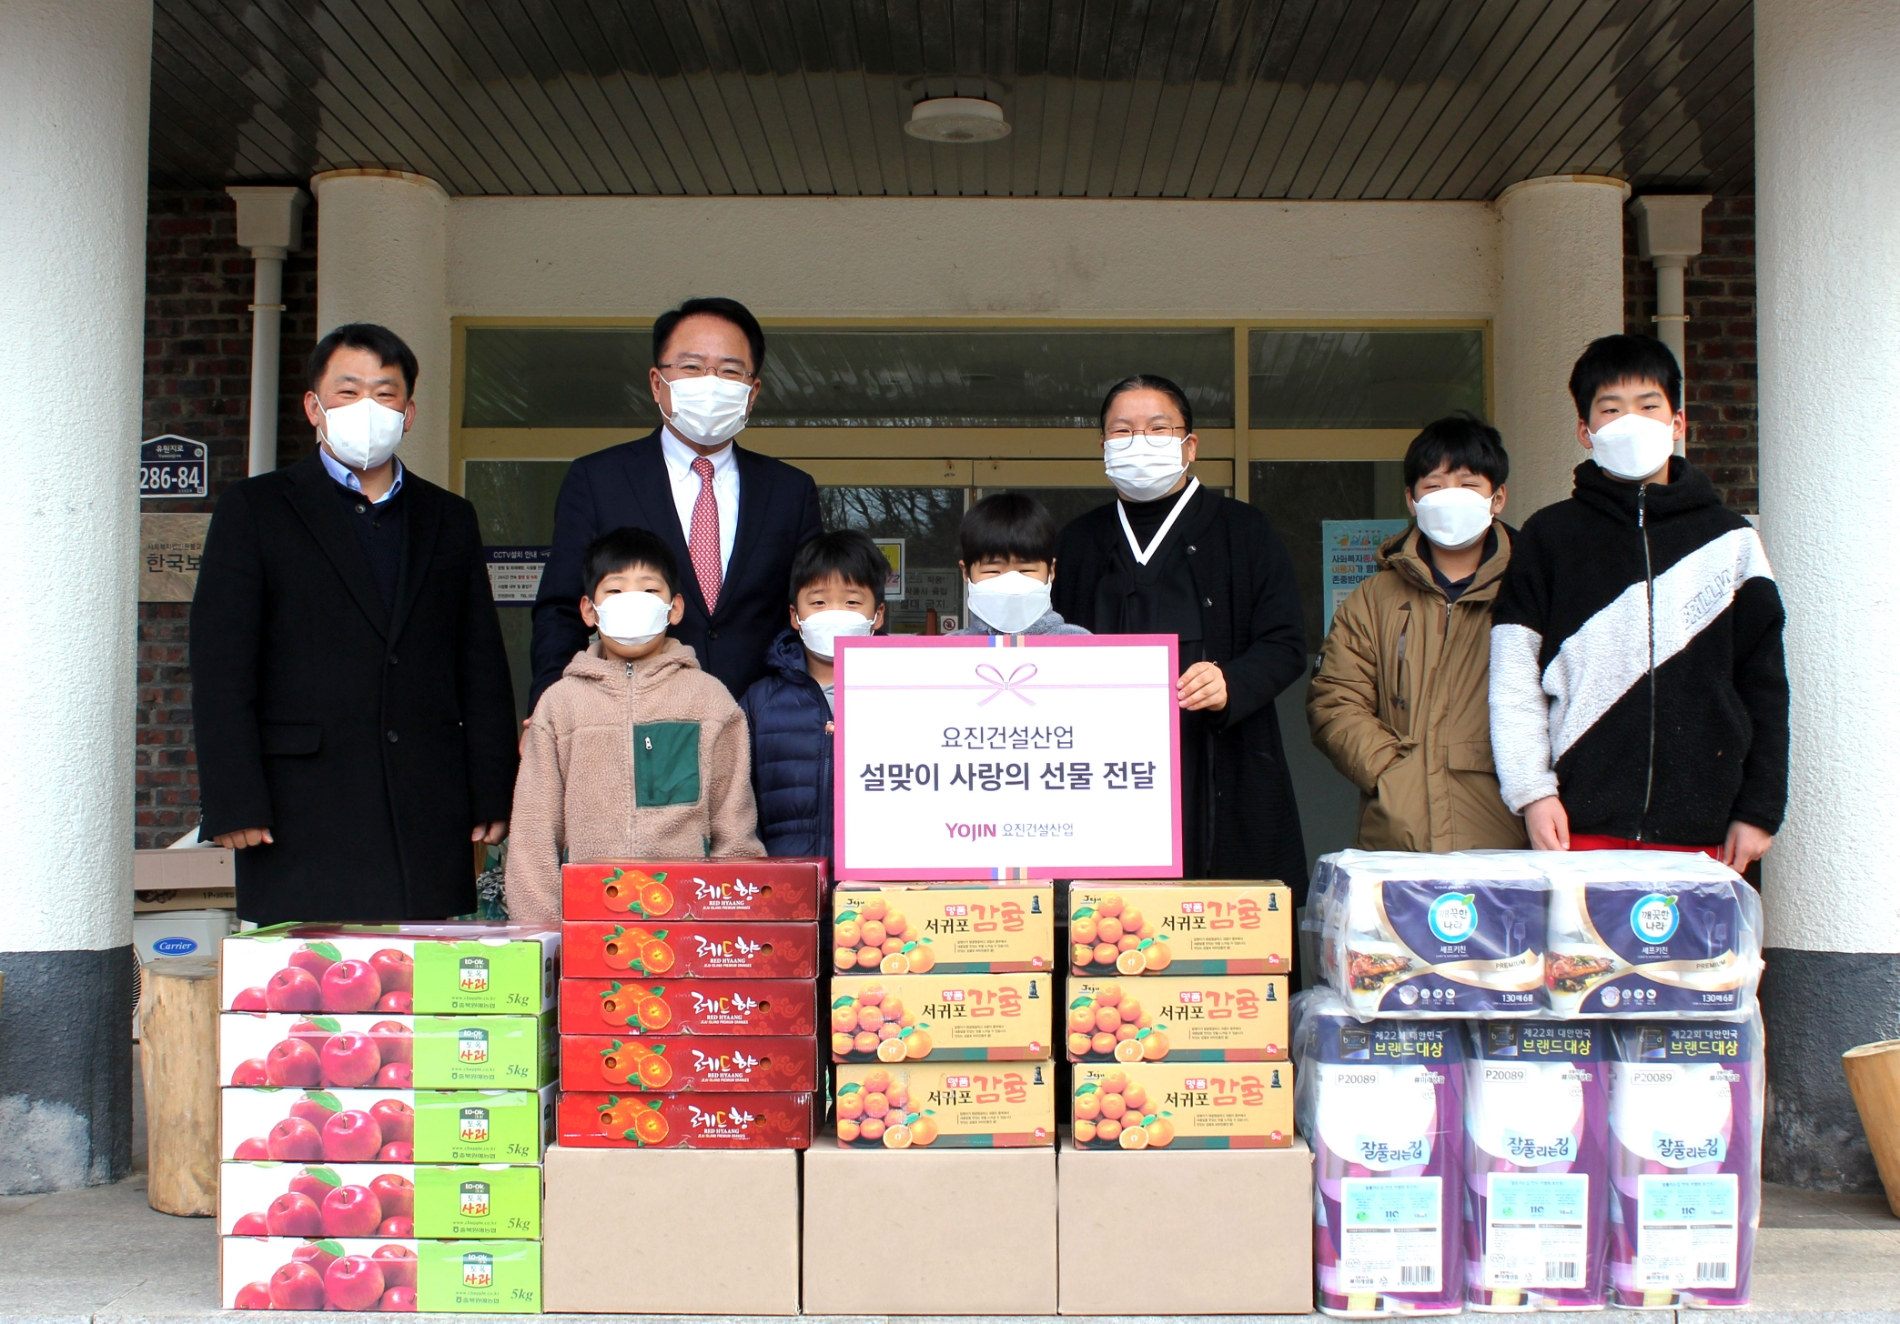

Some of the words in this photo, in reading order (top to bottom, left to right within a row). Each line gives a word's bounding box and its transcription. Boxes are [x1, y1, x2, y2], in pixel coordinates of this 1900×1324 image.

[155, 444, 185, 454] 유원지로
[140, 466, 200, 490] 286-84
[493, 550, 523, 559] CCTV설치
[524, 550, 538, 559] 안내
[1332, 565, 1363, 574] 이용자가
[940, 725, 1075, 750] 요진건설산업
[859, 762, 940, 792] 설맞이
[949, 762, 1030, 791] 사랑의
[1039, 761, 1094, 791] 선물
[1102, 760, 1157, 790] 전달
[944, 822, 997, 842] YOJIN
[1002, 822, 1075, 838] 요진건설산업
[692, 877, 760, 901] 레드향
[846, 898, 866, 908] Jeju
[1084, 896, 1102, 905] Jeju
[946, 906, 967, 916] 명품
[1183, 903, 1204, 913] 명품
[1438, 908, 1468, 920] 깨끗한
[924, 918, 970, 934] 서귀포
[970, 901, 1026, 932] 감귤
[1162, 915, 1208, 932] 서귀포
[1208, 898, 1262, 930] 감귤
[1640, 909, 1670, 921] 깨끗한
[1444, 920, 1463, 930] 나라
[1646, 921, 1665, 931] 나라
[159, 942, 192, 951] Carrier
[694, 935, 761, 959] 레드향
[1496, 958, 1526, 969] PREMIUM
[1696, 959, 1726, 969] PREMIUM
[461, 978, 487, 990] 사과
[943, 991, 964, 1001] 명품
[1082, 986, 1100, 995] Jeju
[506, 993, 530, 1006] 5kg
[690, 991, 758, 1015] 레드향
[922, 1003, 968, 1020] 서귀포
[968, 986, 1022, 1018] 감귤
[1181, 993, 1202, 1003] 명품
[1502, 994, 1523, 1002] 130매
[1702, 994, 1723, 1002] 130매
[1160, 1005, 1206, 1022] 서귀포
[1206, 988, 1260, 1020] 감귤
[1409, 1031, 1443, 1040] 대한민국
[1523, 1028, 1554, 1038] 제22회
[1557, 1028, 1591, 1038] 대한민국
[1671, 1030, 1702, 1040] 제22회
[1705, 1030, 1739, 1040] 대한민국
[1374, 1042, 1444, 1058] 브랜드대상
[1522, 1039, 1592, 1055] 브랜드대상
[1670, 1041, 1740, 1057] 브랜드대상
[460, 1048, 486, 1061] 사과
[692, 1049, 759, 1073] 레드향
[505, 1064, 529, 1078] 5kg
[1086, 1072, 1106, 1082] Jeju
[1486, 1070, 1524, 1080] P20089
[949, 1078, 970, 1088] 명품
[1338, 1074, 1376, 1084] P20089
[1634, 1073, 1672, 1082] P20089
[928, 1090, 974, 1106] 서귀포
[974, 1073, 1028, 1104] 감귤
[1186, 1080, 1207, 1090] 명품
[1164, 1092, 1210, 1108] 서귀포
[1210, 1075, 1266, 1106] 감귤
[688, 1105, 755, 1129] 레드향
[461, 1128, 487, 1140] 사과
[506, 1143, 530, 1156] 5kg
[1360, 1139, 1423, 1160] 잘풀리는집
[1507, 1135, 1570, 1156] 잘풀리는집
[1656, 1136, 1719, 1158] 잘풀리는집
[462, 1202, 488, 1215] 사과
[507, 1218, 531, 1232] 5kg
[465, 1272, 491, 1285] 사과
[510, 1288, 534, 1302] 5kg
